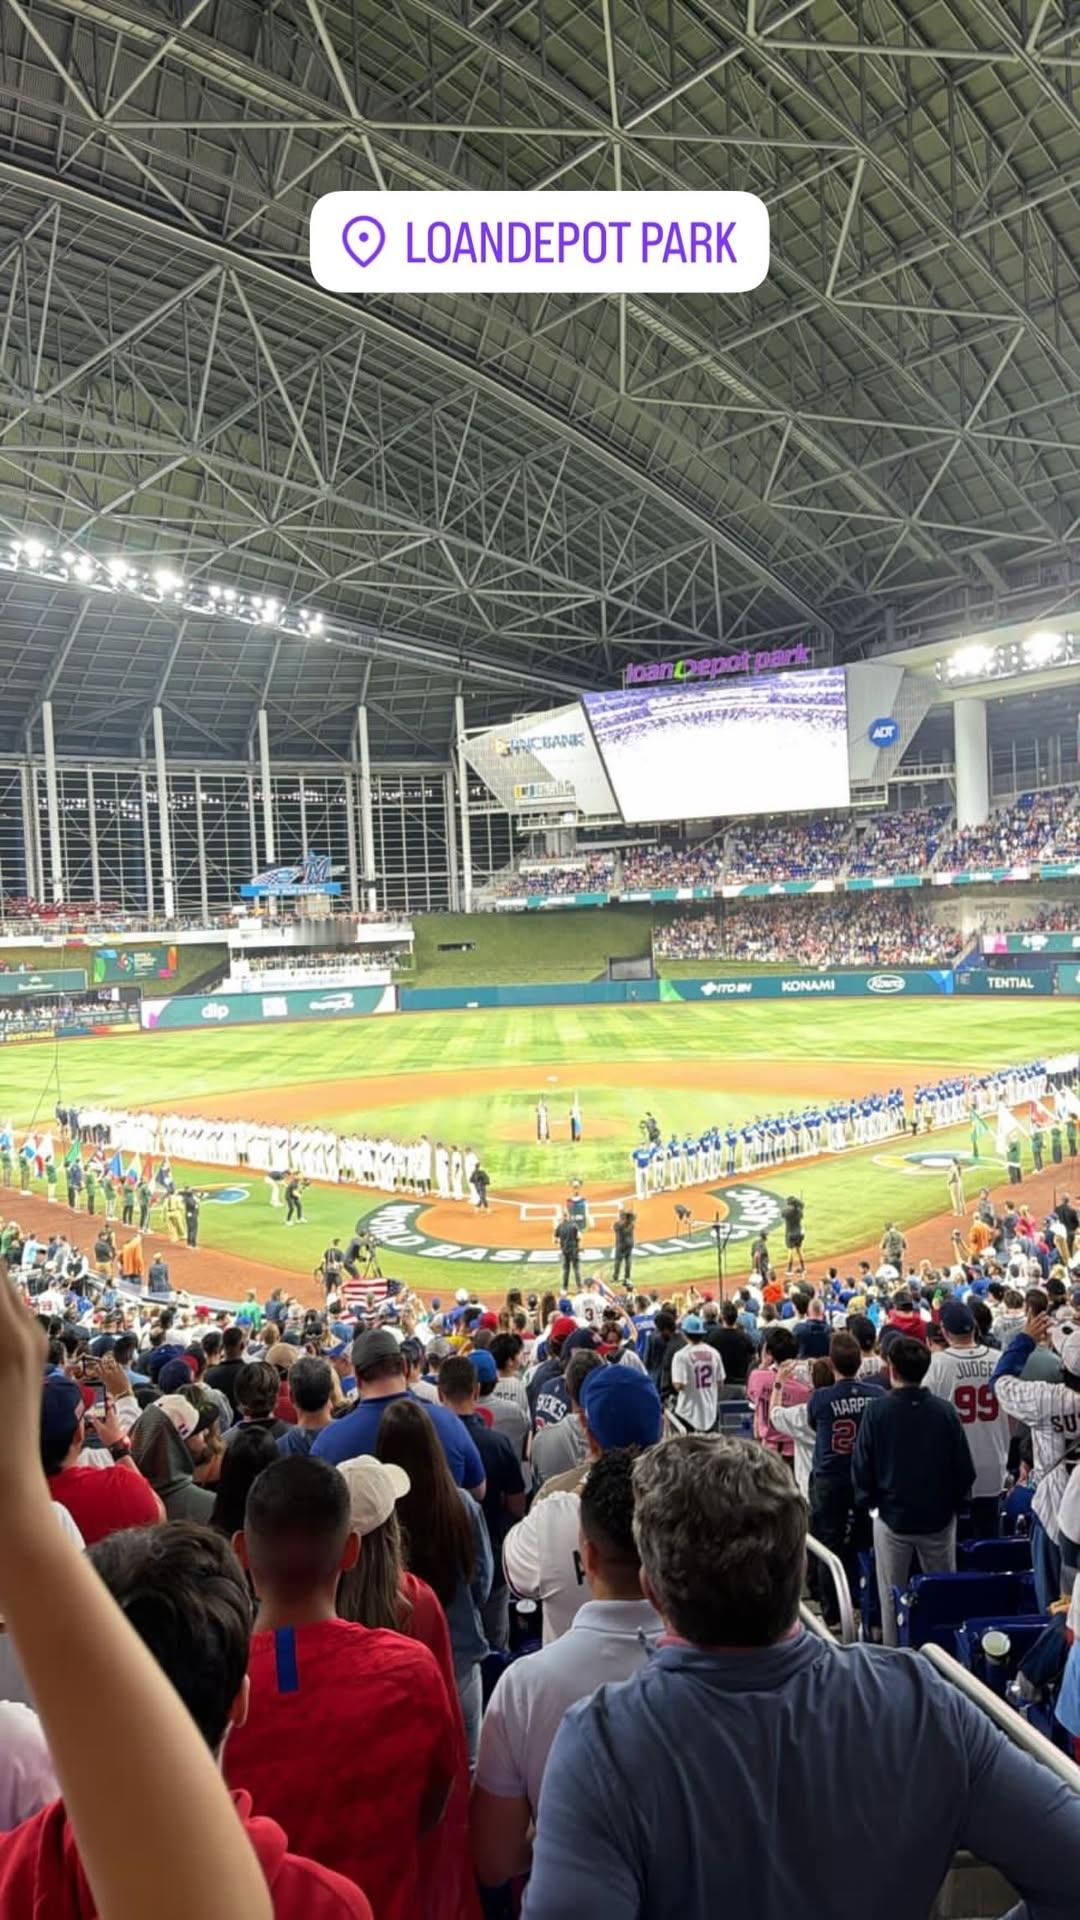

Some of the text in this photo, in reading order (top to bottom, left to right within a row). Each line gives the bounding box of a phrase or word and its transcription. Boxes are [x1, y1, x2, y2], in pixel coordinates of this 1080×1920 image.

[755, 643, 810, 672] park
[872, 725, 896, 739] ADT
[782, 978, 835, 992] KONAMI
[986, 977, 1035, 989] TENTIAL
[367, 1204, 426, 1247] WORLD
[710, 1188, 781, 1240] CLASSIC
[584, 1307, 594, 1322] 3
[694, 1364, 713, 1389] 12
[956, 1361, 994, 1380] JUDGE
[954, 1384, 999, 1424] 99
[1050, 1414, 1080, 1434] SU
